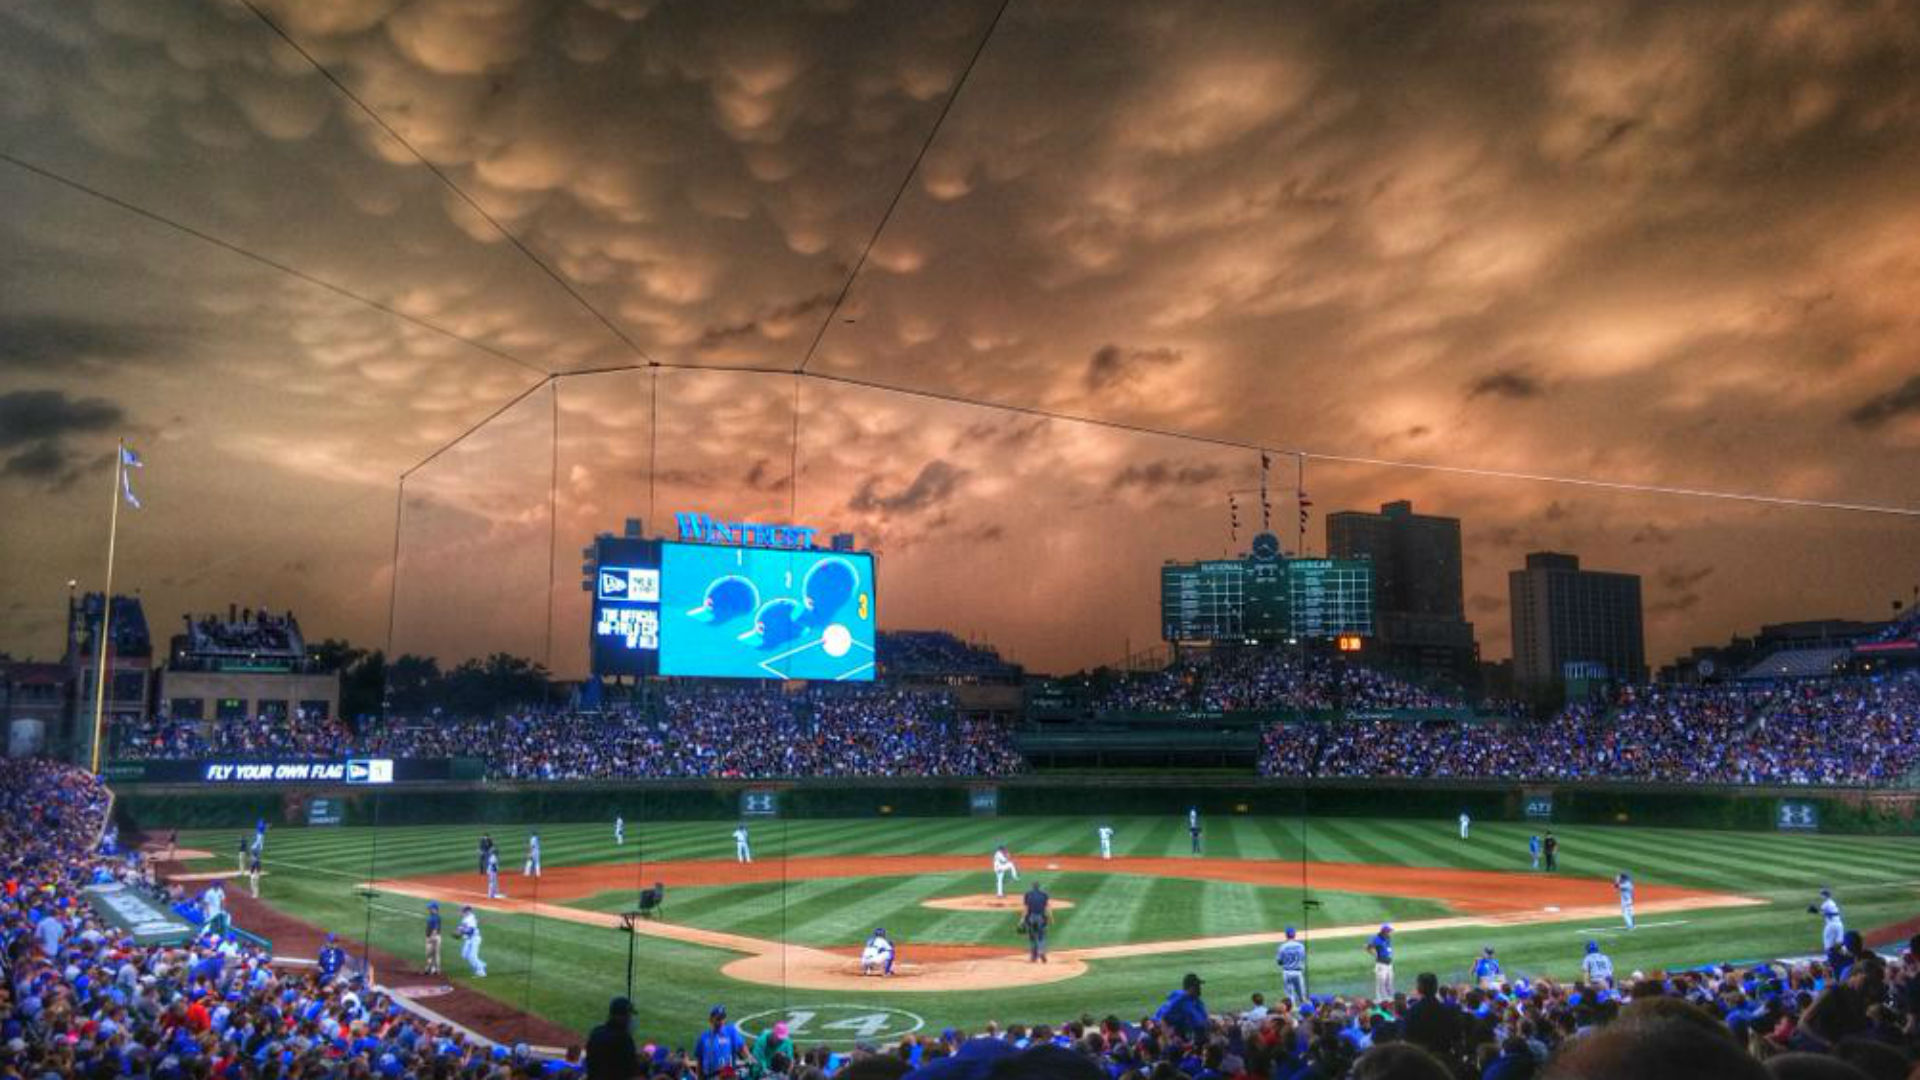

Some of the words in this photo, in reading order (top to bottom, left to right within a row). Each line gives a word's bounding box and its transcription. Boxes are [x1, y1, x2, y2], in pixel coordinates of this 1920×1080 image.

[857, 592, 869, 620] 3
[207, 765, 234, 779] FLY
[236, 765, 273, 778] YOUR
[275, 765, 309, 778] OWN
[311, 765, 344, 778] FLAG
[786, 1009, 892, 1037] 14
